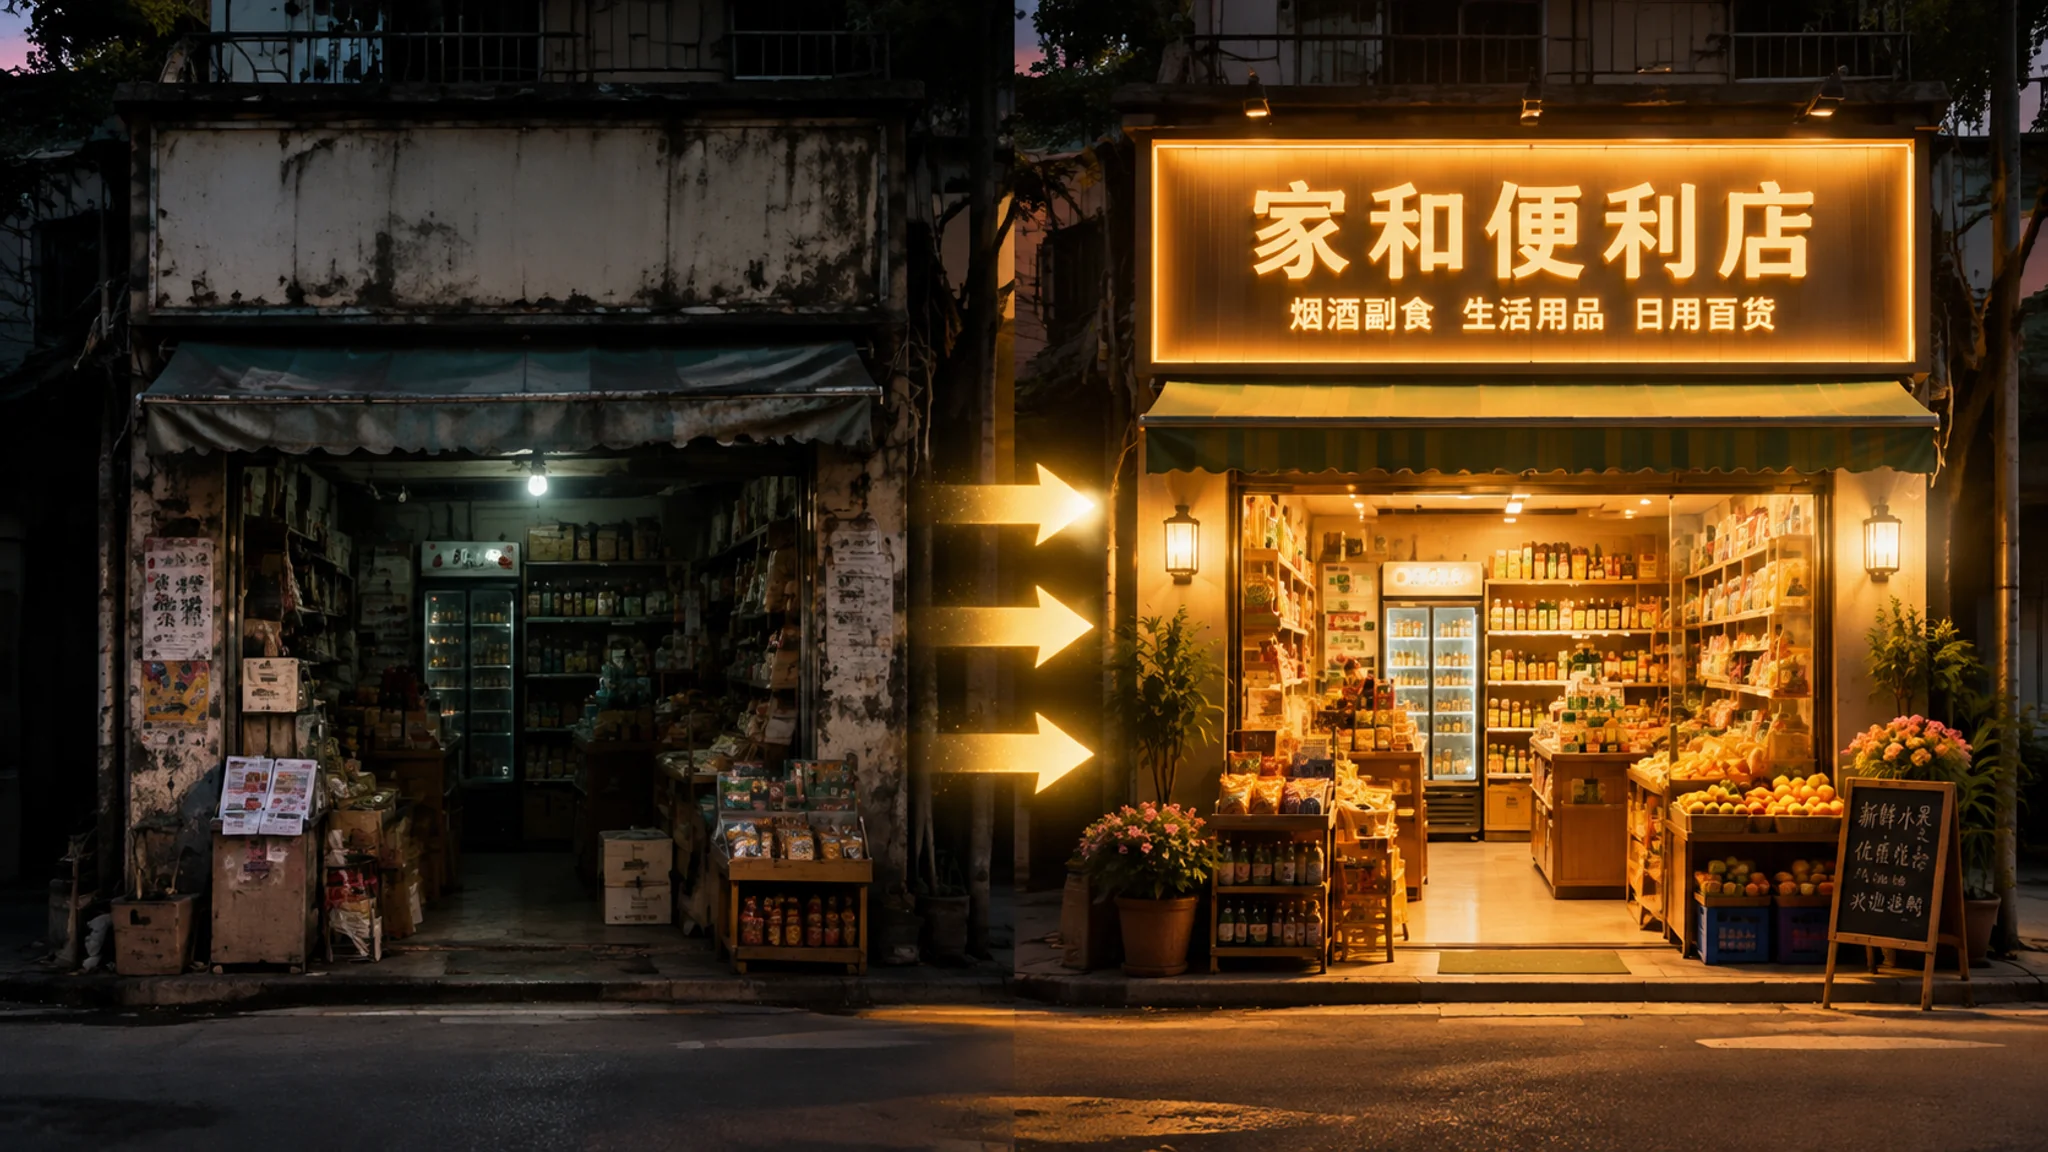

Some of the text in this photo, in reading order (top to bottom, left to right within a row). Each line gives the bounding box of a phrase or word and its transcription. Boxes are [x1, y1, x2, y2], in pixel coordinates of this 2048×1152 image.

[1253, 179, 1814, 279] 家和便利店
[1290, 296, 1776, 331] 烟酒副食 生活用品 日用百货
